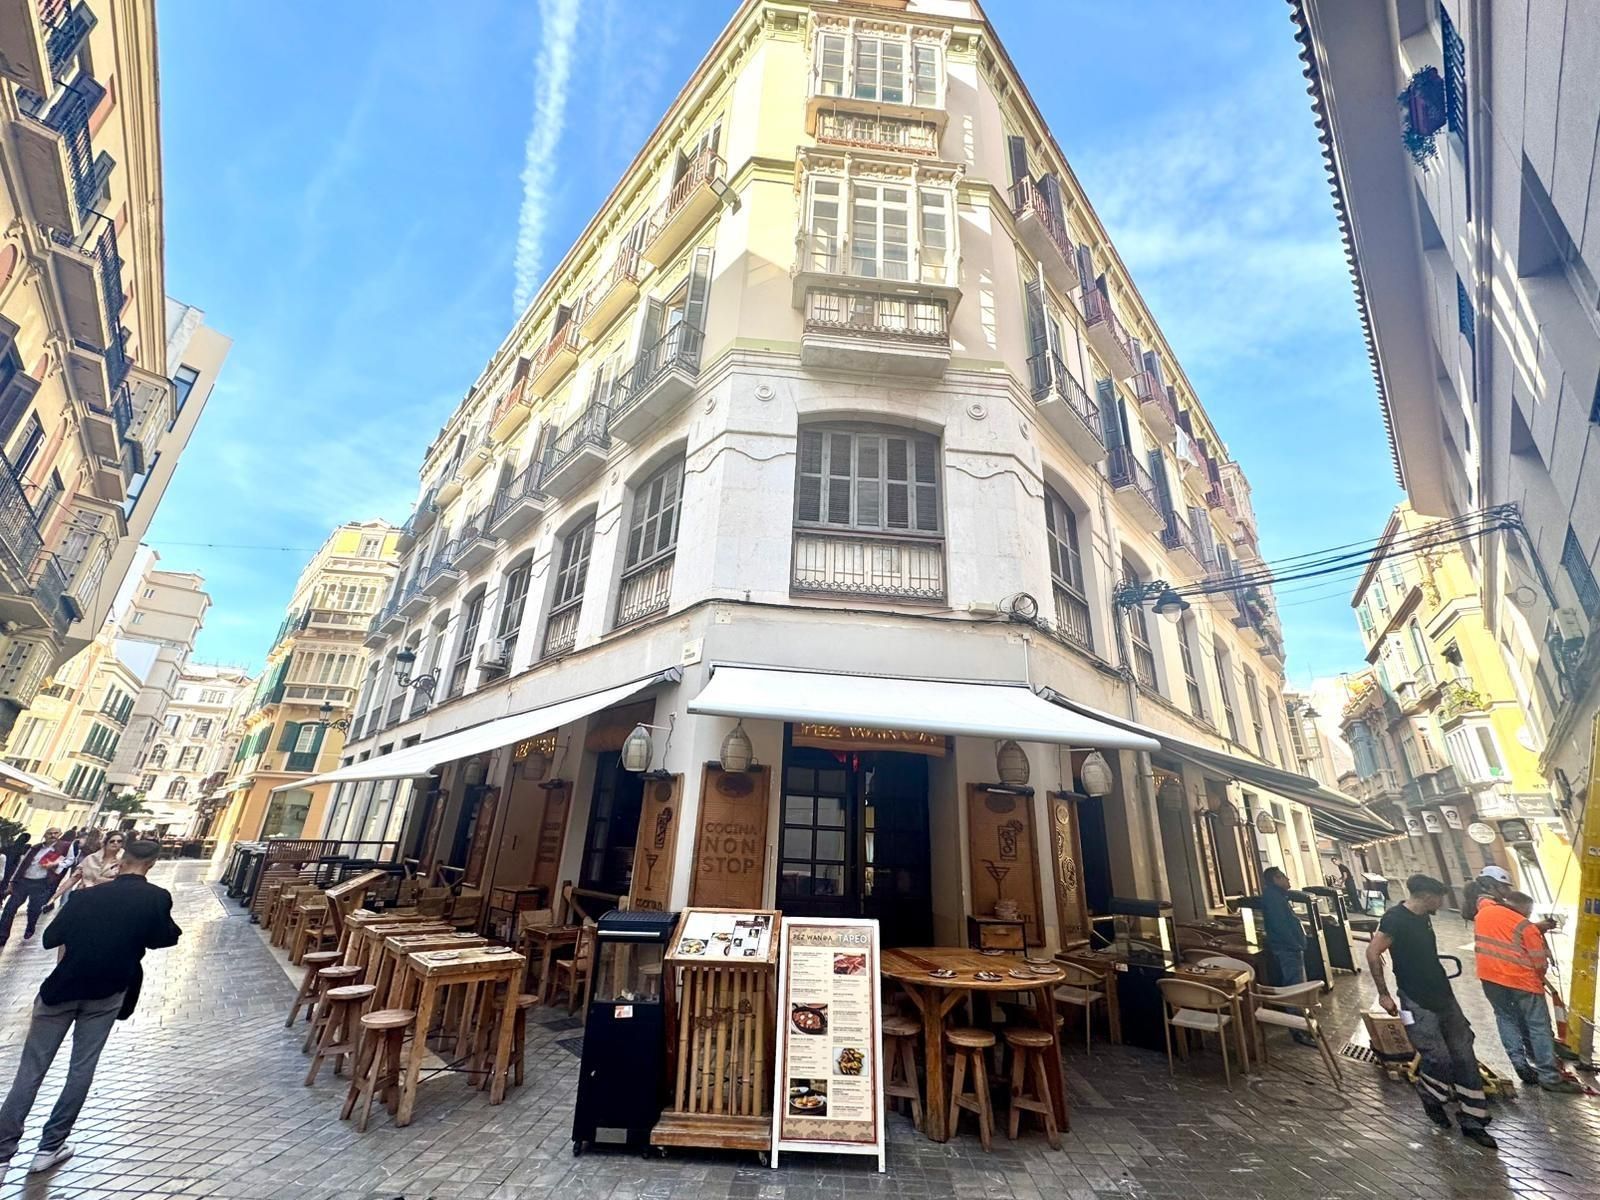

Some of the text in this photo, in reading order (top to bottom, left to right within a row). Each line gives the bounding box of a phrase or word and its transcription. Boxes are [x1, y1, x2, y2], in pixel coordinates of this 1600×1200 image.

[705, 822, 759, 836] COCINA
[704, 836, 755, 855] NON
[702, 856, 755, 874] STOP
[793, 933, 868, 944] PEZ WANDA TAPEO
